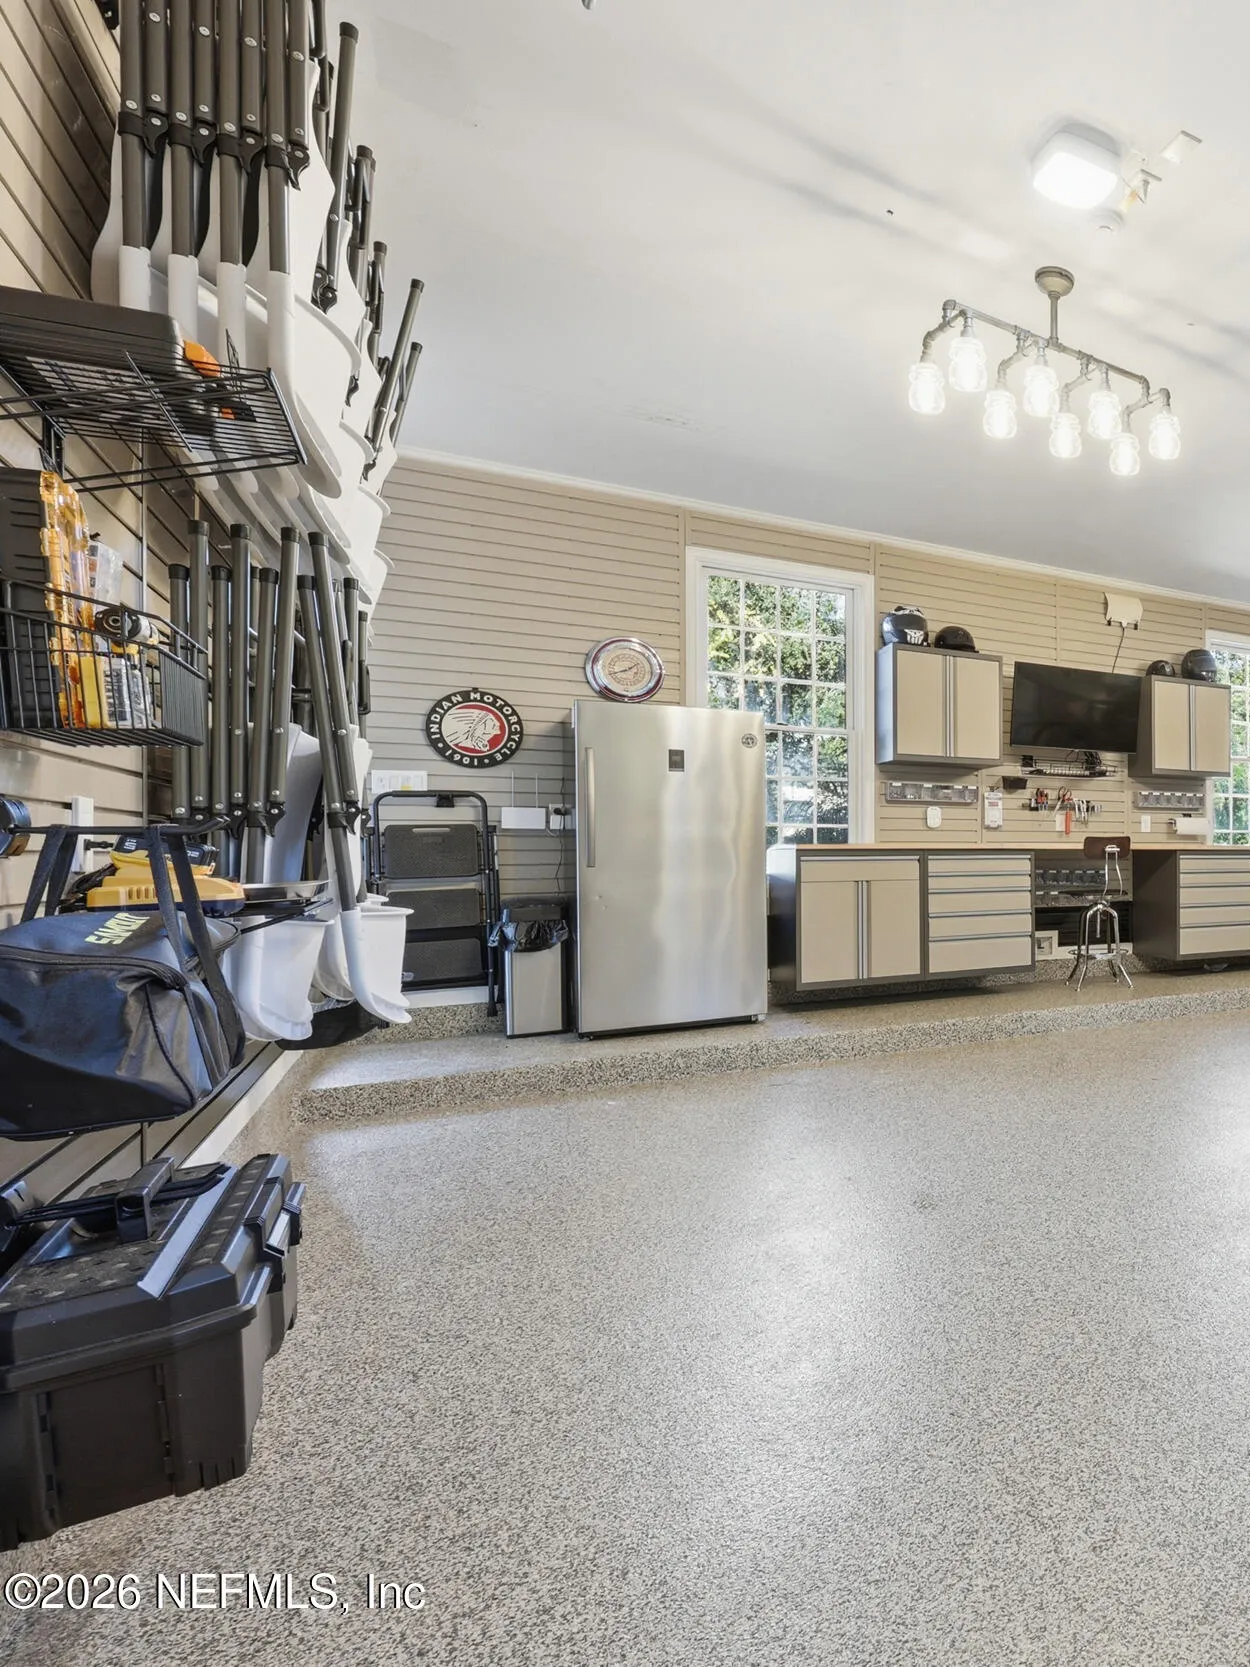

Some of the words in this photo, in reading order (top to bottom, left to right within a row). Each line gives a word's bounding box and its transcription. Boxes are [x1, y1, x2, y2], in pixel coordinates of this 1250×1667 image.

[429, 693, 463, 739] INDIAN
[470, 692, 521, 761] MOTORCYCLE
[445, 749, 478, 766] 1901
